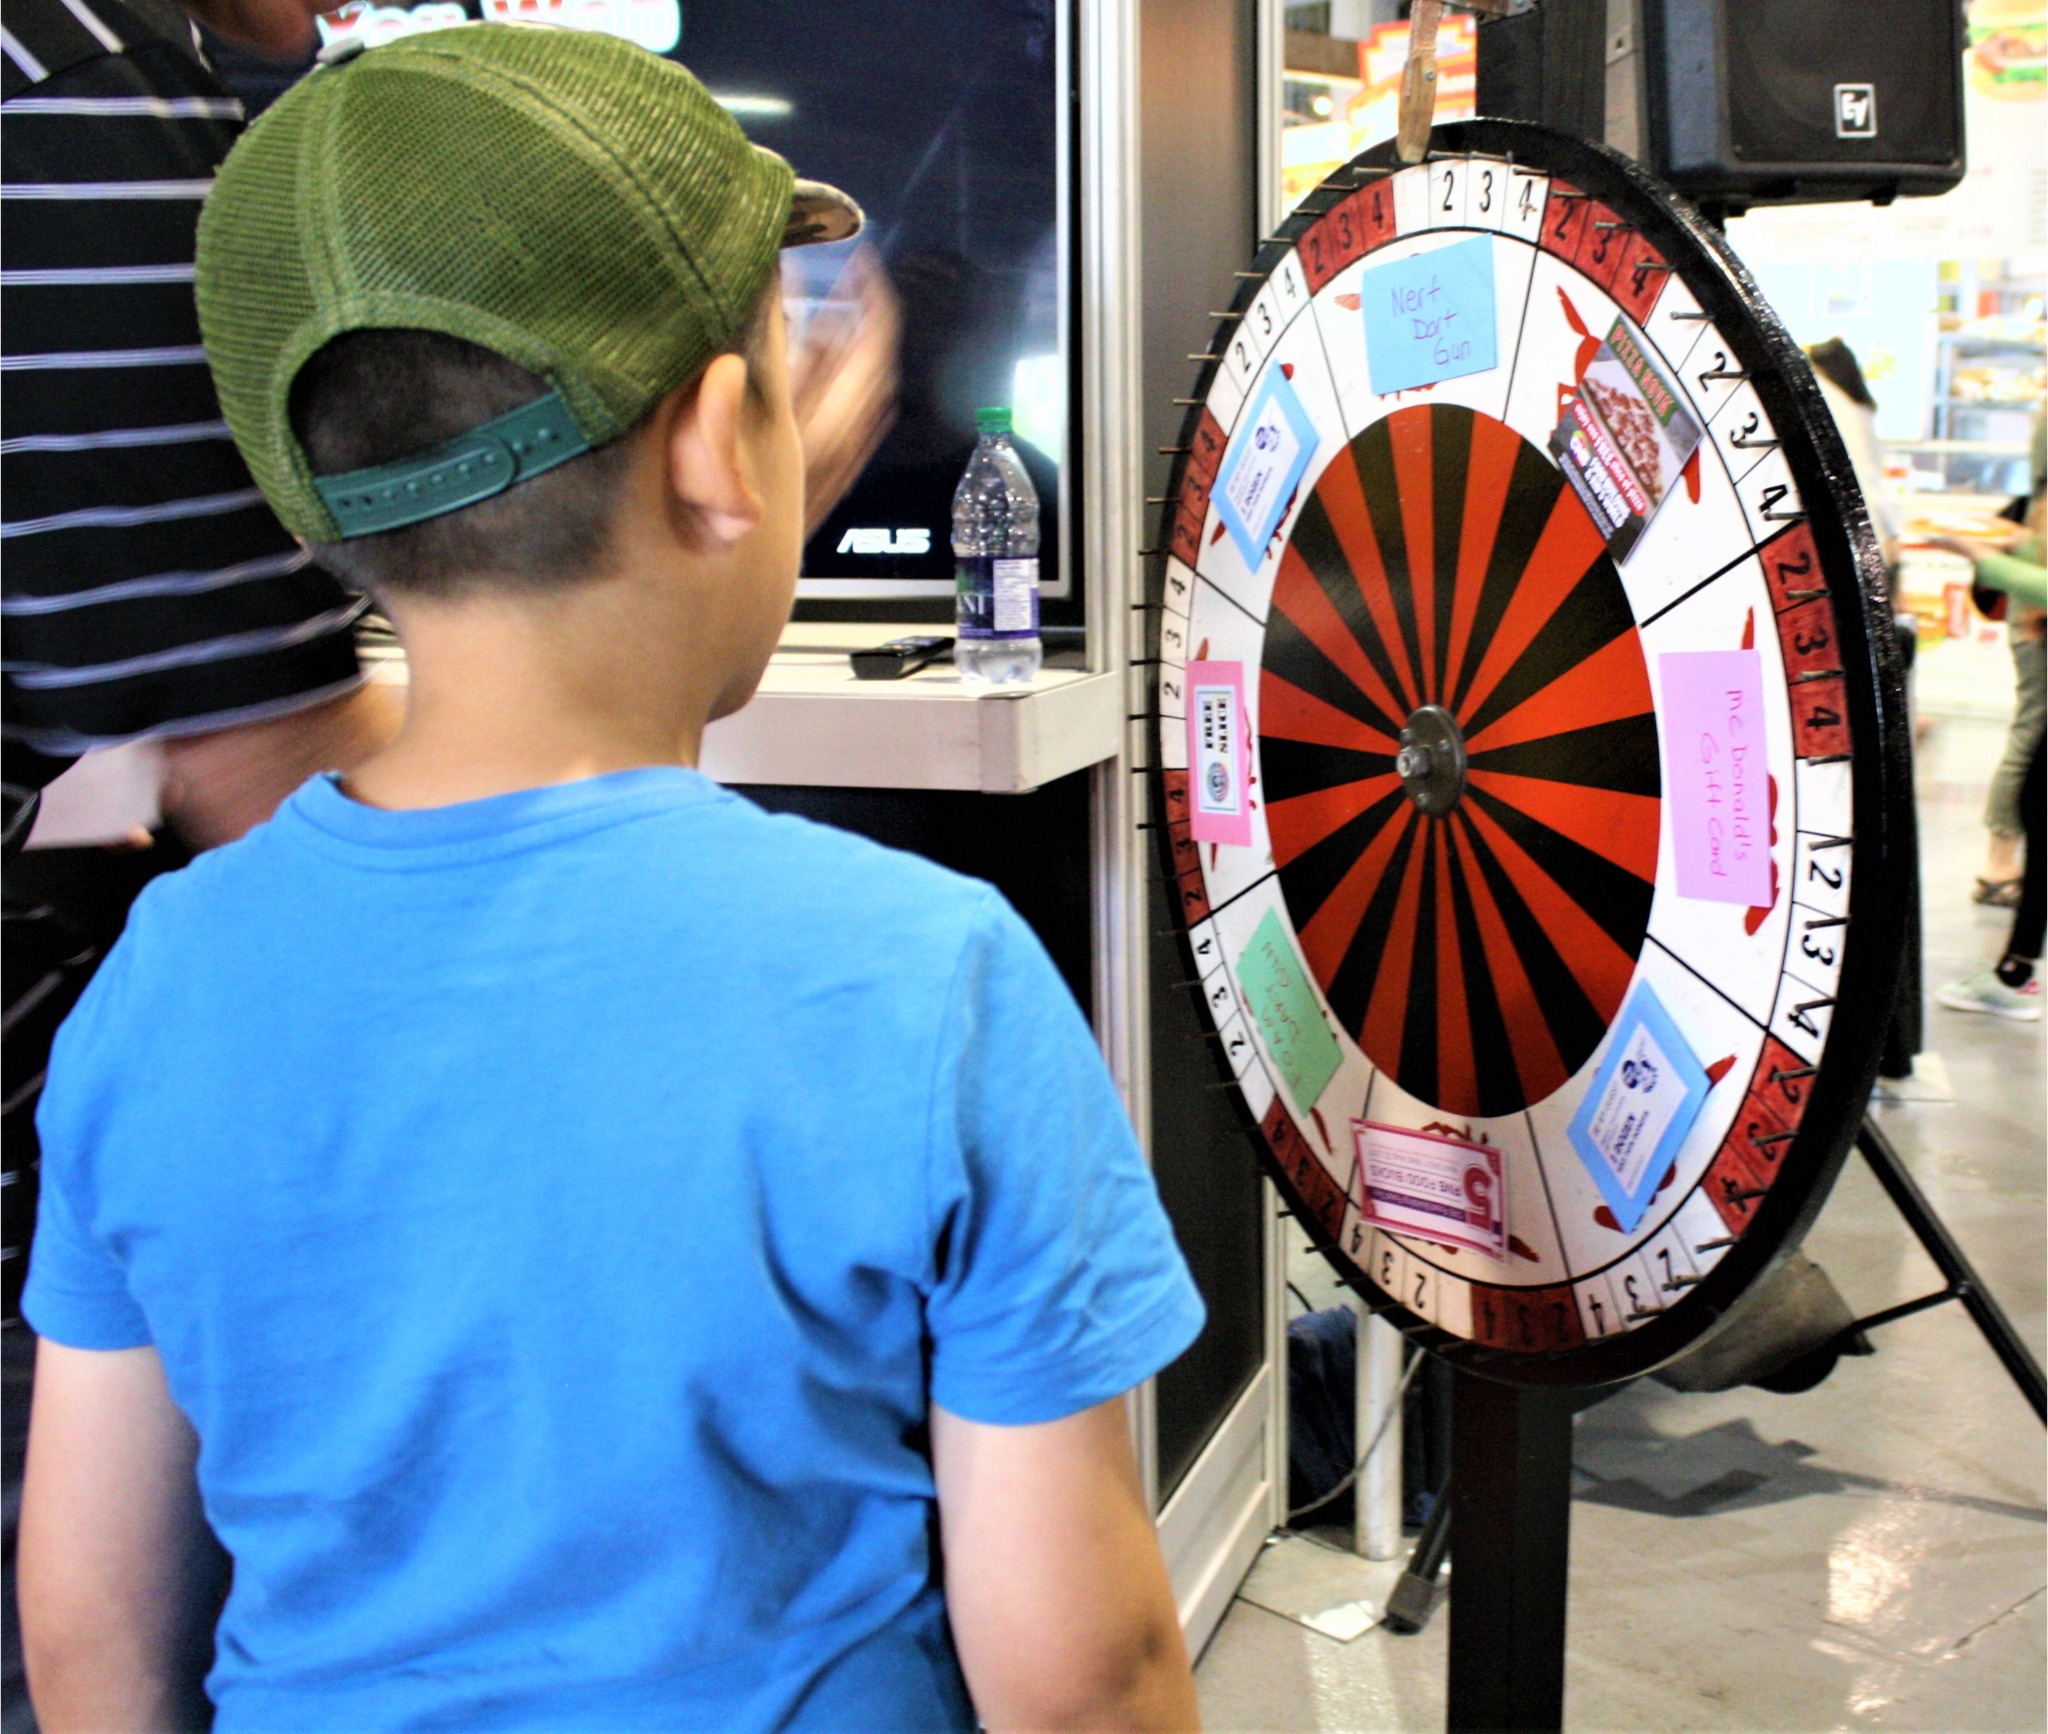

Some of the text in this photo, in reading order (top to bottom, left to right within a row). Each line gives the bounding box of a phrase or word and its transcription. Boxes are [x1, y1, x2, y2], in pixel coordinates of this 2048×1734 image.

[1310, 190, 1384, 274] 2 3 4
[1443, 170, 1537, 221] 2 3 4
[1555, 197, 1652, 298] 2 3 4
[1235, 265, 1297, 375] 2 3 4
[1433, 336, 1471, 366] Gun
[1610, 323, 1674, 418] PIZZA NOVA
[1593, 435, 1616, 467] FREE
[1626, 488, 1646, 512] pizza
[1699, 351, 1788, 514] 2 3 4
[837, 528, 930, 553] ASUS
[1163, 576, 1186, 699] 2 3 4
[1777, 552, 1841, 731] 2 3 4
[1203, 701, 1214, 749] FREE
[1217, 698, 1228, 753] SLICE
[1701, 732, 1728, 877] Gift Card
[1788, 859, 1843, 1039] 2 3 4
[1197, 938, 1246, 1057] 2 3 4
[1768, 1064, 1800, 1105] 2
[1369, 1164, 1462, 1197] FIVE FOOD BUCKS
[1747, 1122, 1777, 1162] 3
[1464, 1166, 1492, 1231] 5
[1352, 1224, 1426, 1309] 2 3 4
[1588, 1248, 1683, 1335] 2 3 4
